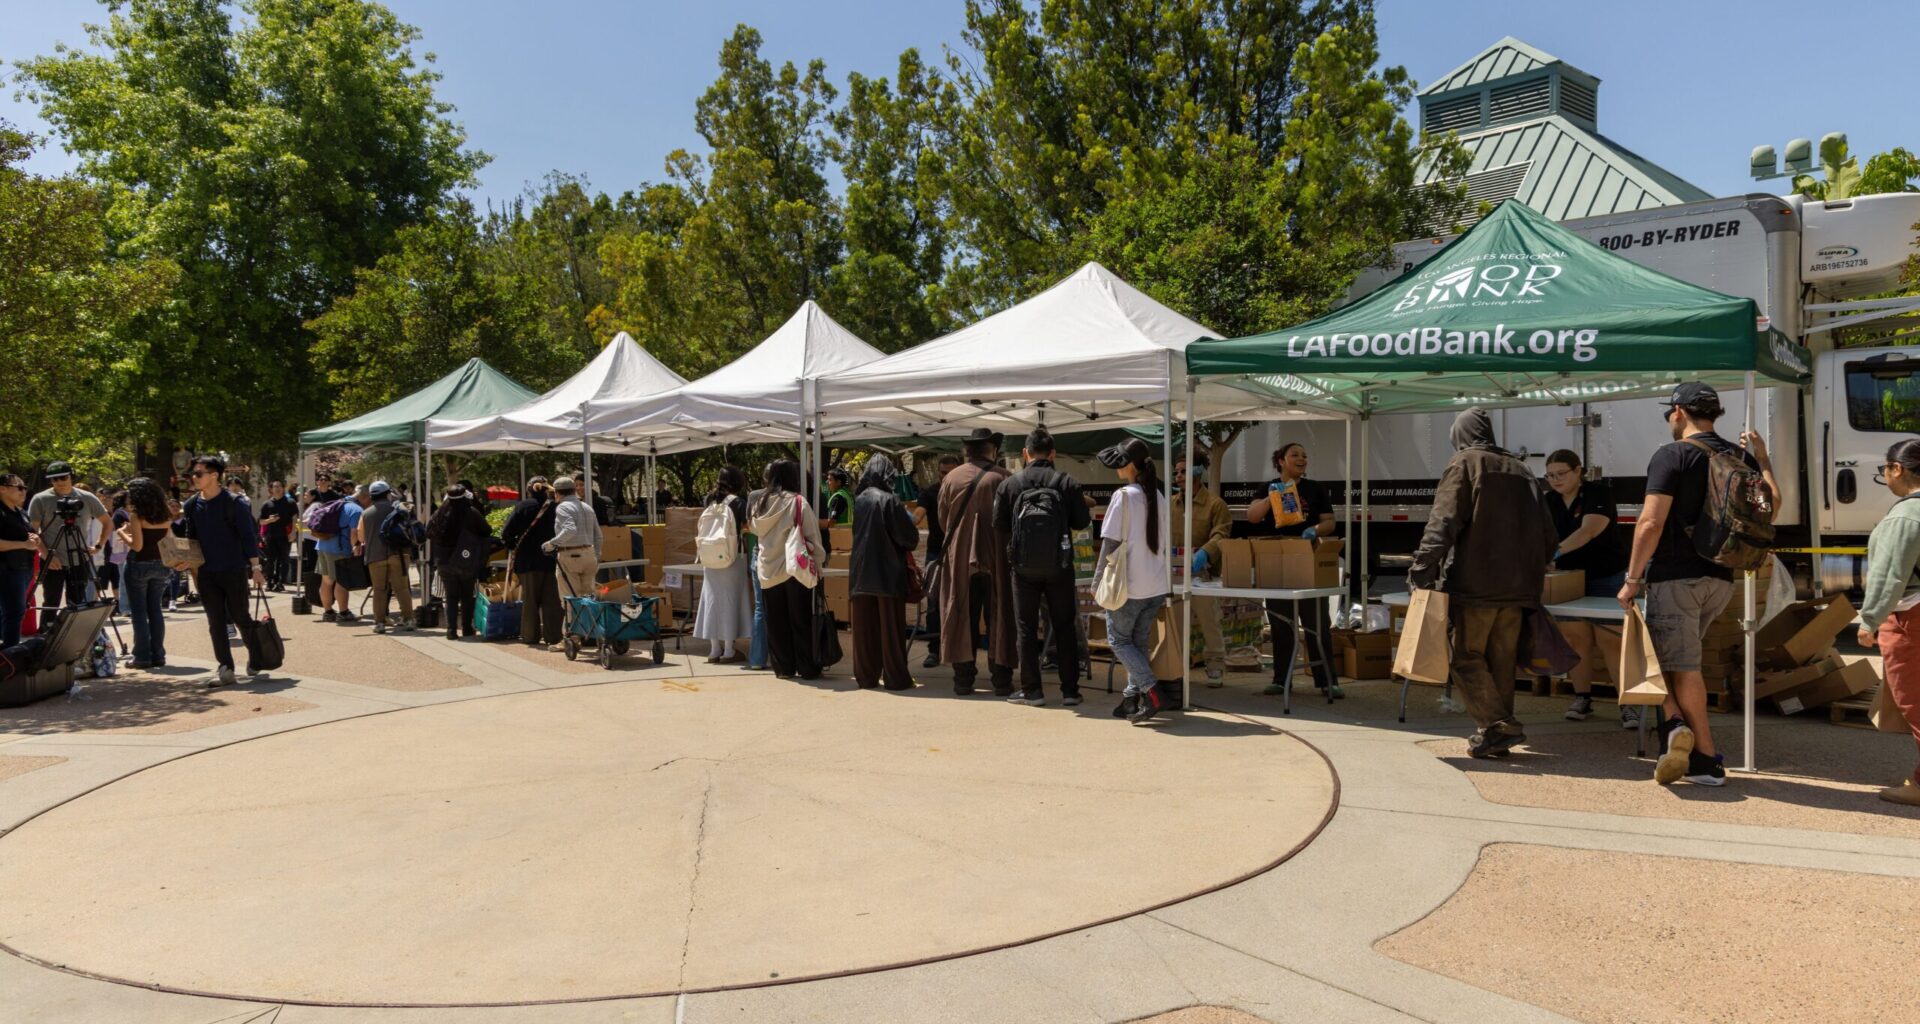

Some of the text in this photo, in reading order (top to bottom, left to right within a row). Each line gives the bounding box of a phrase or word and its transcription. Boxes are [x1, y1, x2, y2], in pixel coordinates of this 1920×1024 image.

[1500, 251, 1567, 260] REGIONAL
[1287, 323, 1599, 362] LAFoodBank.org
[1224, 489, 1257, 498] DEDICATE
[1371, 488, 1394, 497] CHAIN
